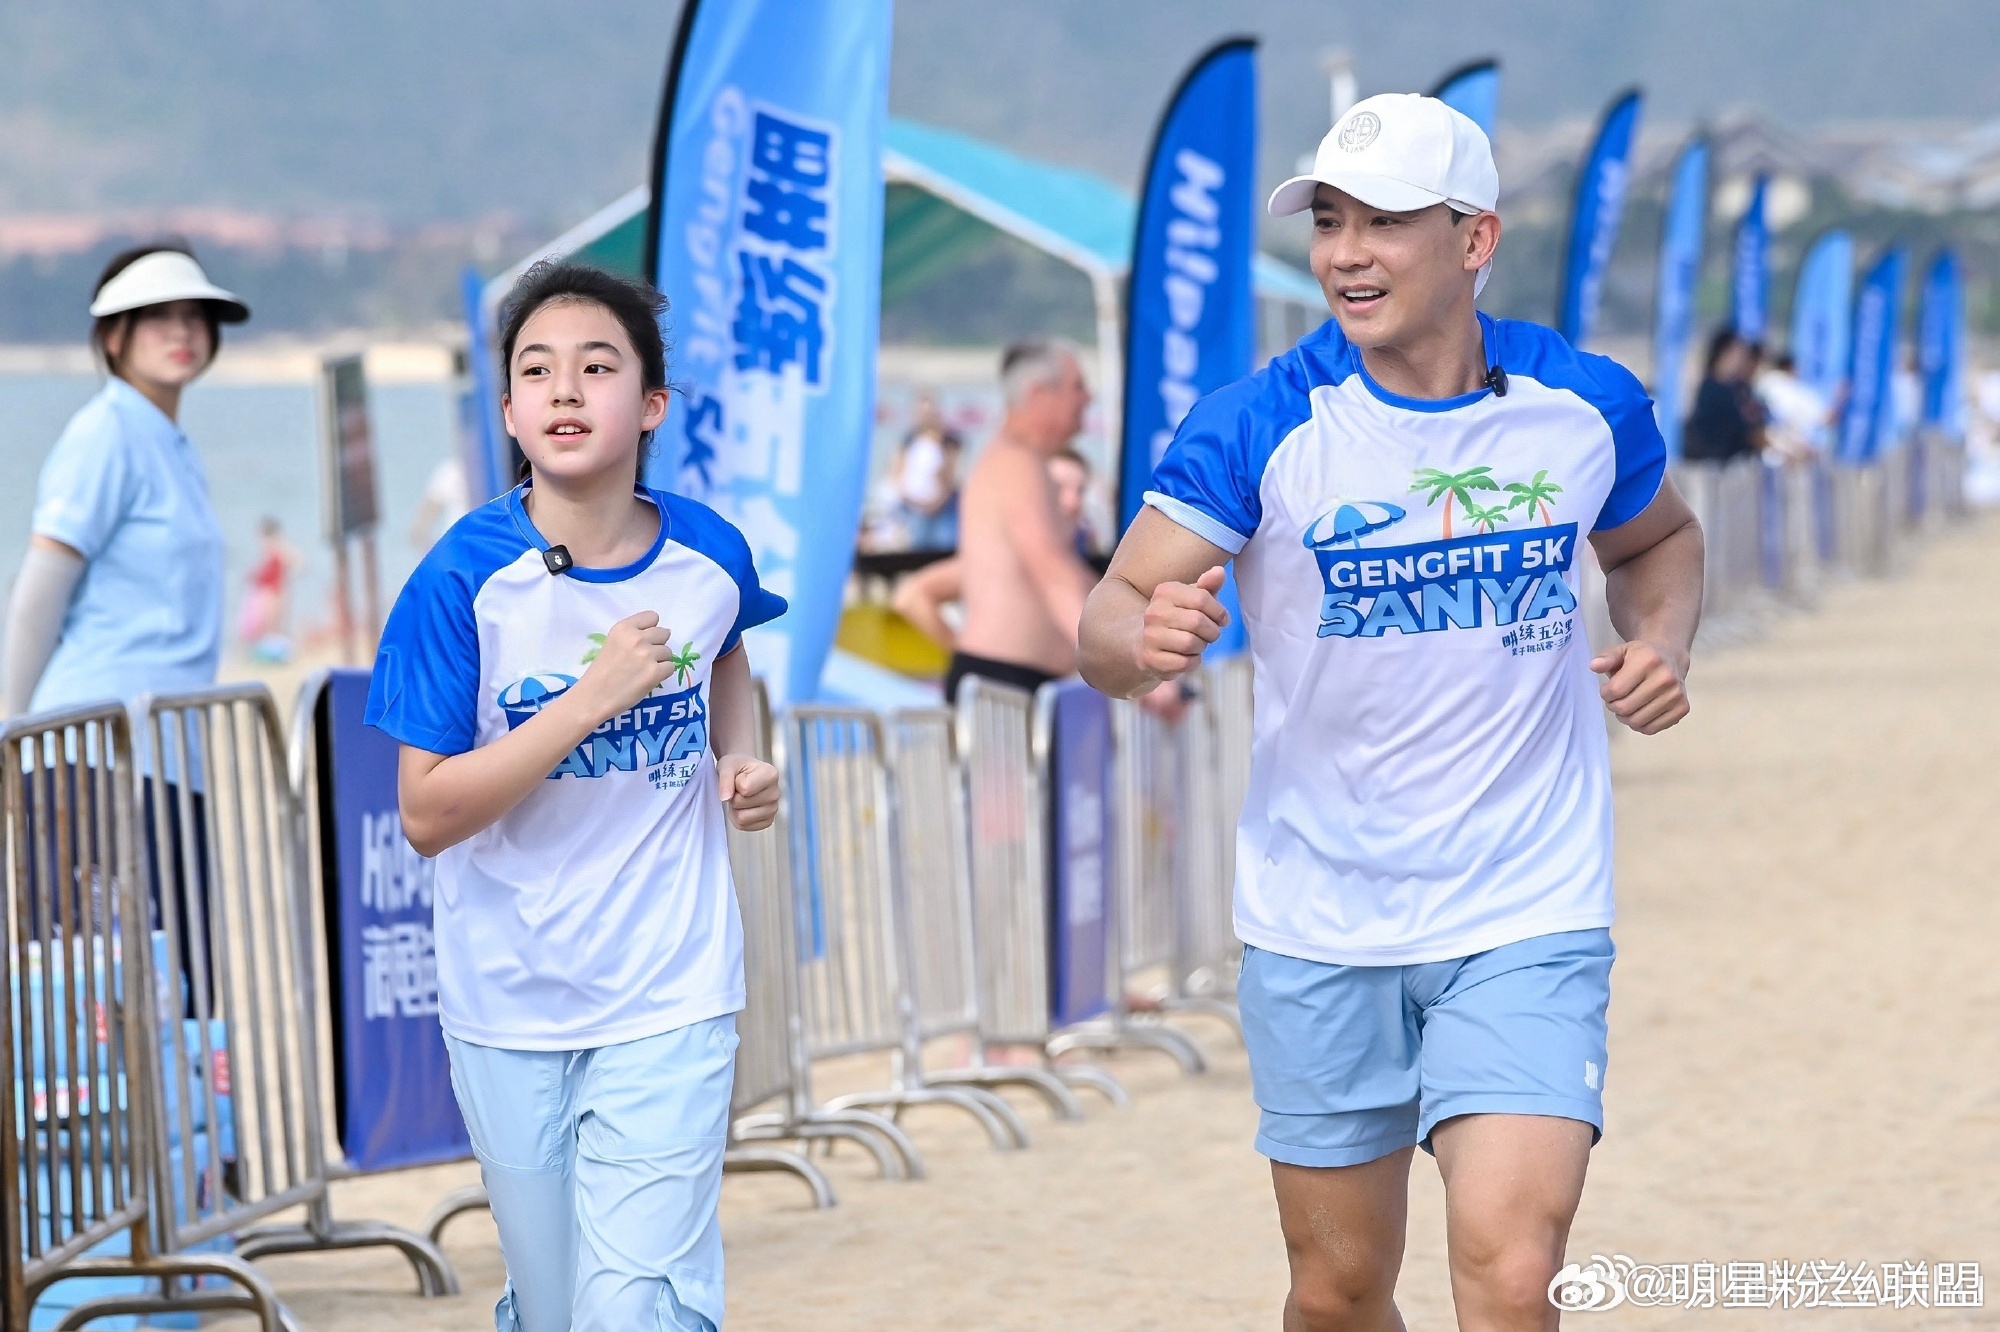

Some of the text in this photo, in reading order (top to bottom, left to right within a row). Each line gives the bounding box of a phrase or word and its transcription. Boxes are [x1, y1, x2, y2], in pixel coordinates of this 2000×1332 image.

[1329, 535, 1569, 588] GENGFIT 5K
[1316, 569, 1577, 639] SANYA
[669, 692, 703, 722] 5K
[545, 719, 707, 780] ANYA
